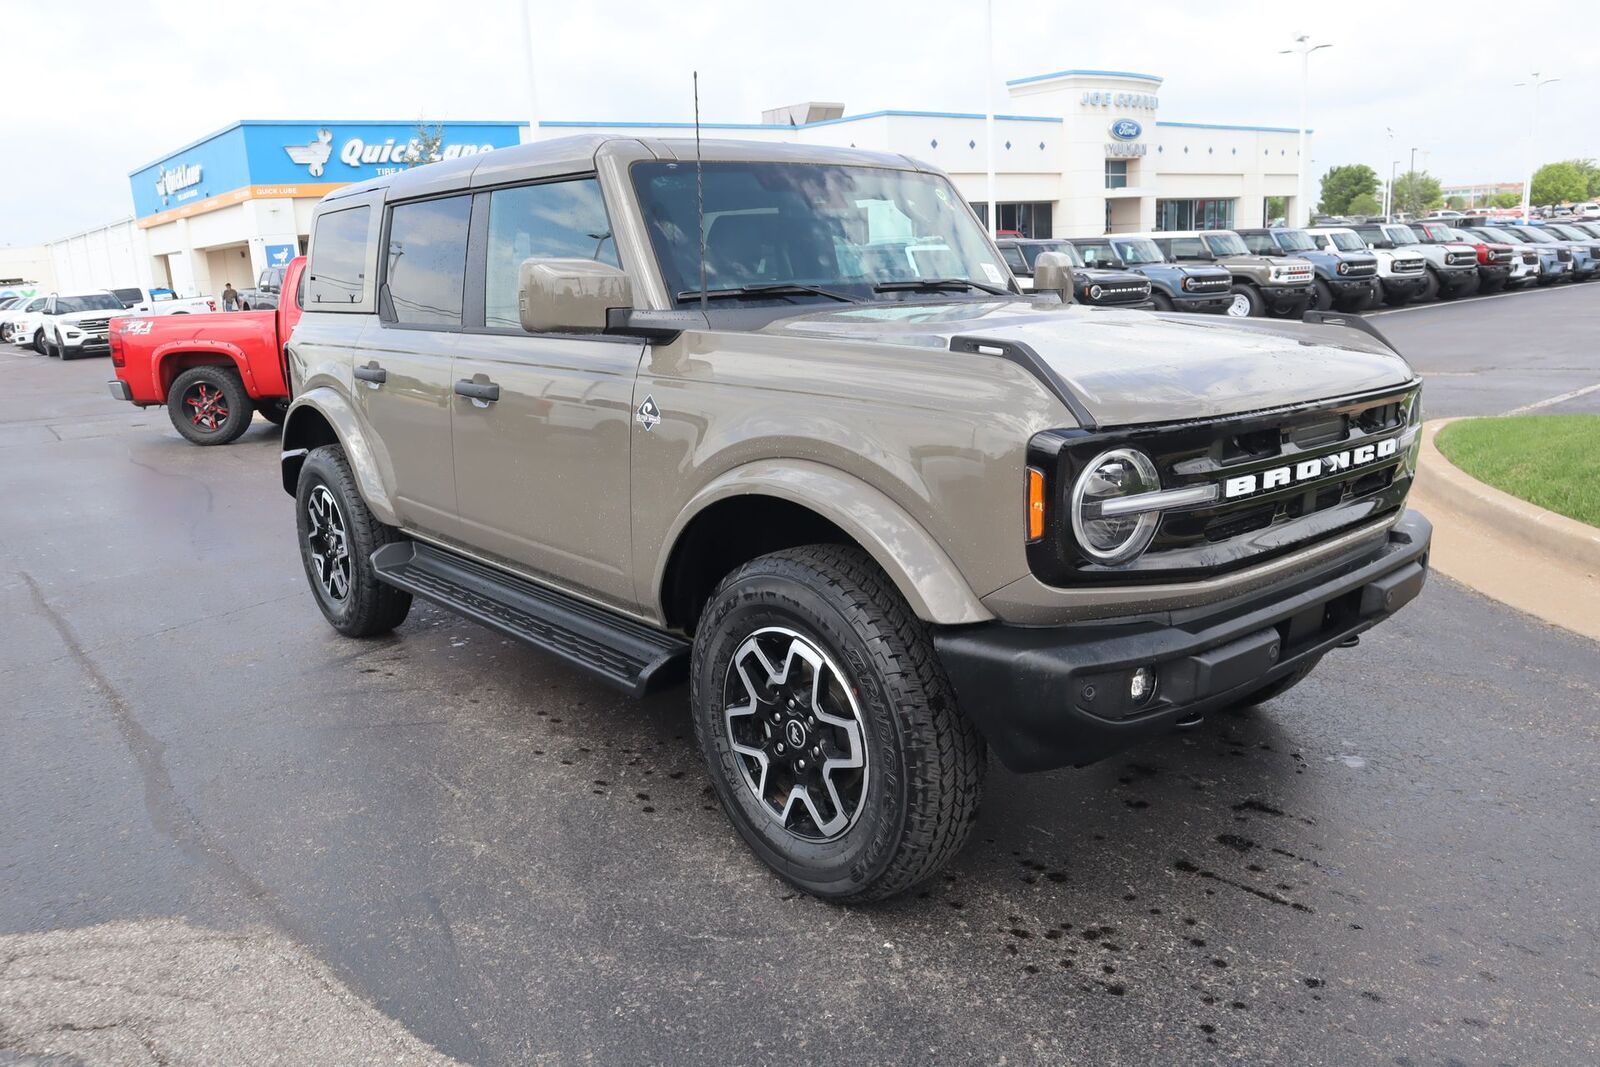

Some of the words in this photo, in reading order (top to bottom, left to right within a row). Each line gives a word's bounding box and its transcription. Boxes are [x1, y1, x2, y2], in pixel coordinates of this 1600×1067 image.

[1081, 92, 1111, 105] JOE
[1118, 122, 1137, 136] Ford
[341, 138, 424, 167] Quick
[376, 167, 396, 176] TIRE
[1225, 438, 1397, 498] BRONCO
